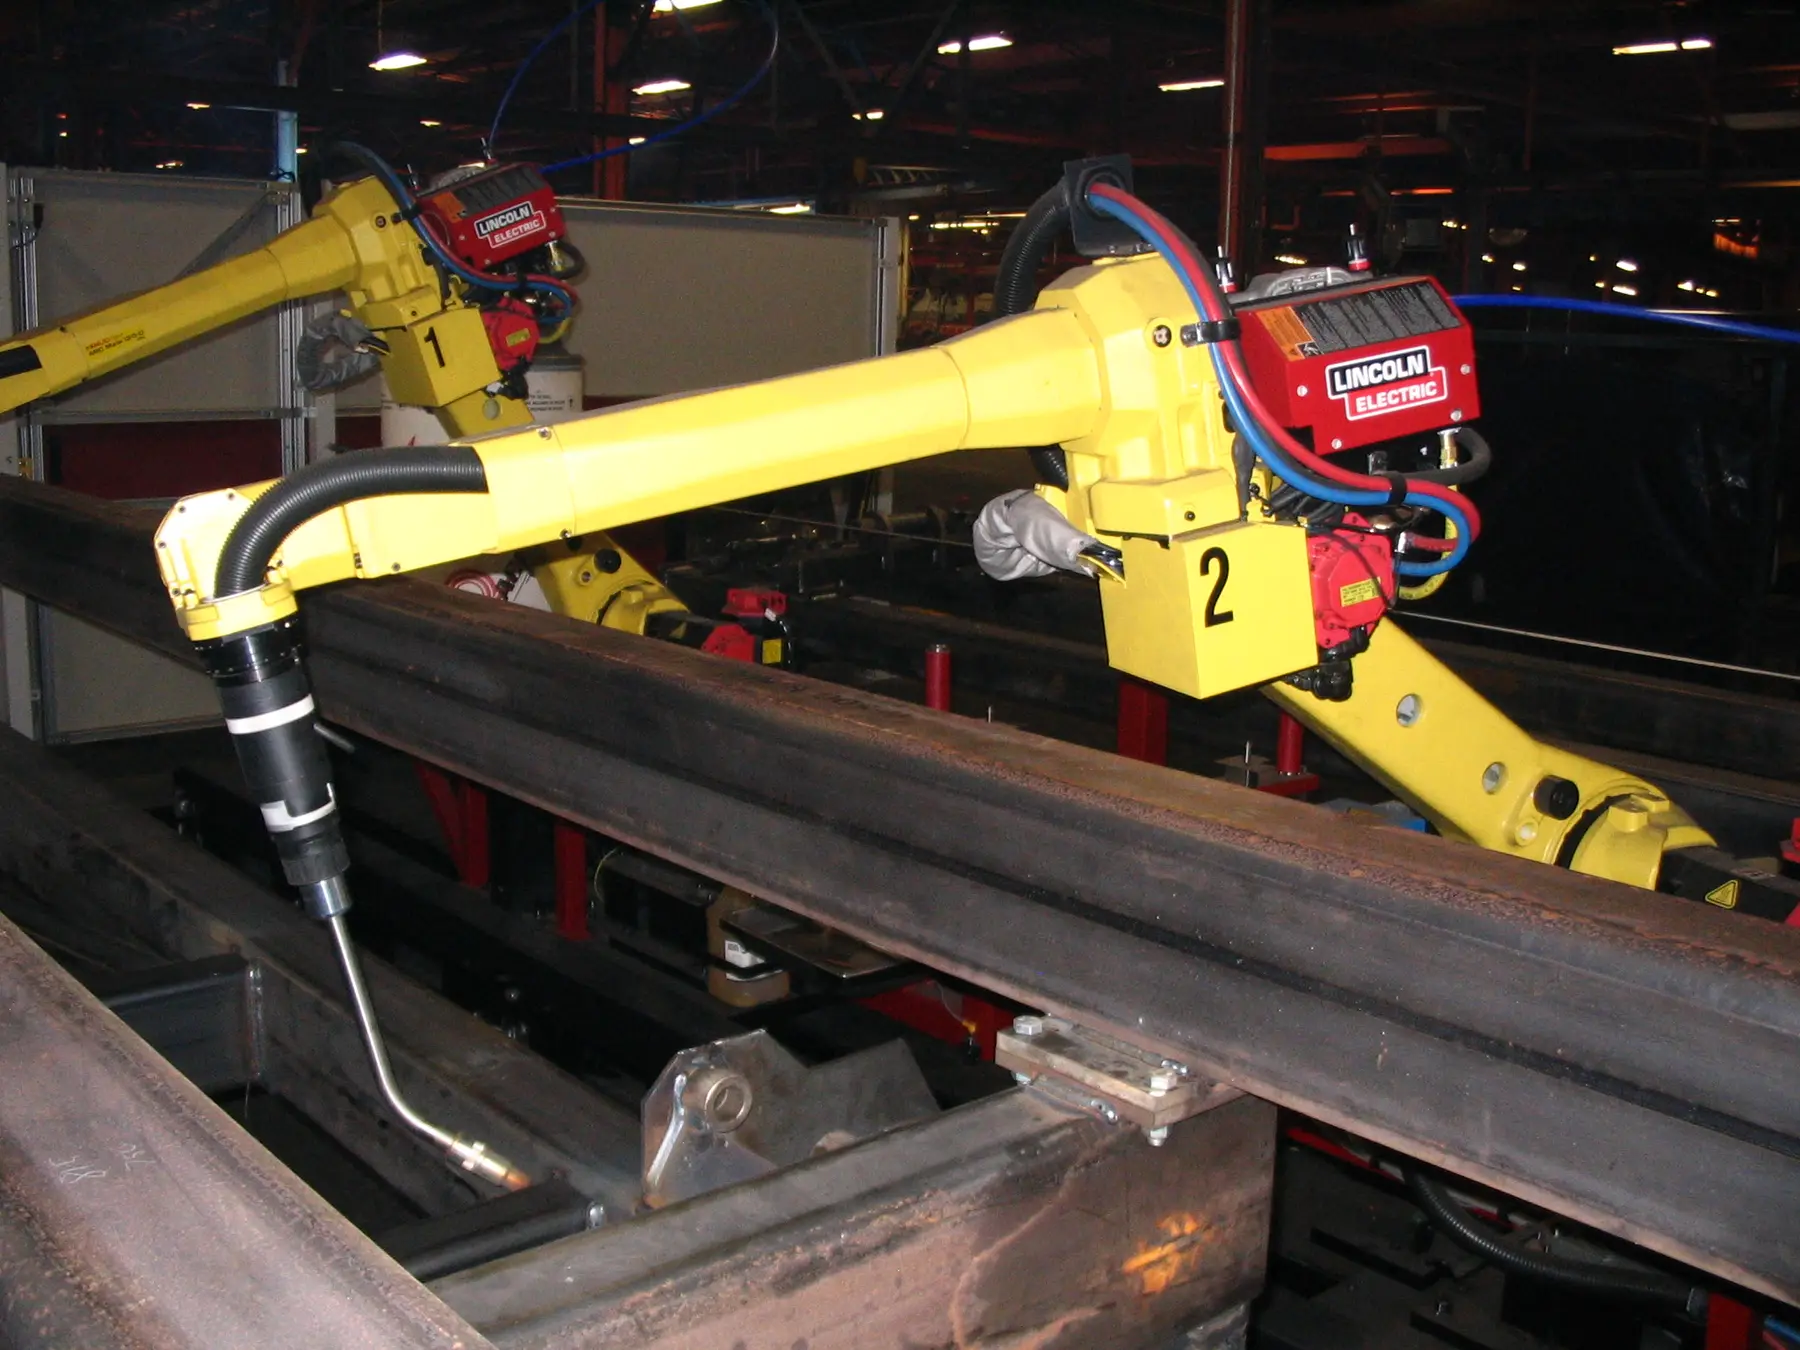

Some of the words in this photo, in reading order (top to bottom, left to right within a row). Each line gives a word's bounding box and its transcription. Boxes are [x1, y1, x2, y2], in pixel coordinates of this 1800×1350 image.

[479, 206, 530, 235] LINCOLN
[494, 219, 541, 243] ELECTRIC
[424, 326, 446, 369] 1
[1334, 353, 1425, 392] LINCOLN
[1356, 381, 1437, 413] ELECTRIC
[1200, 546, 1234, 628] 2
